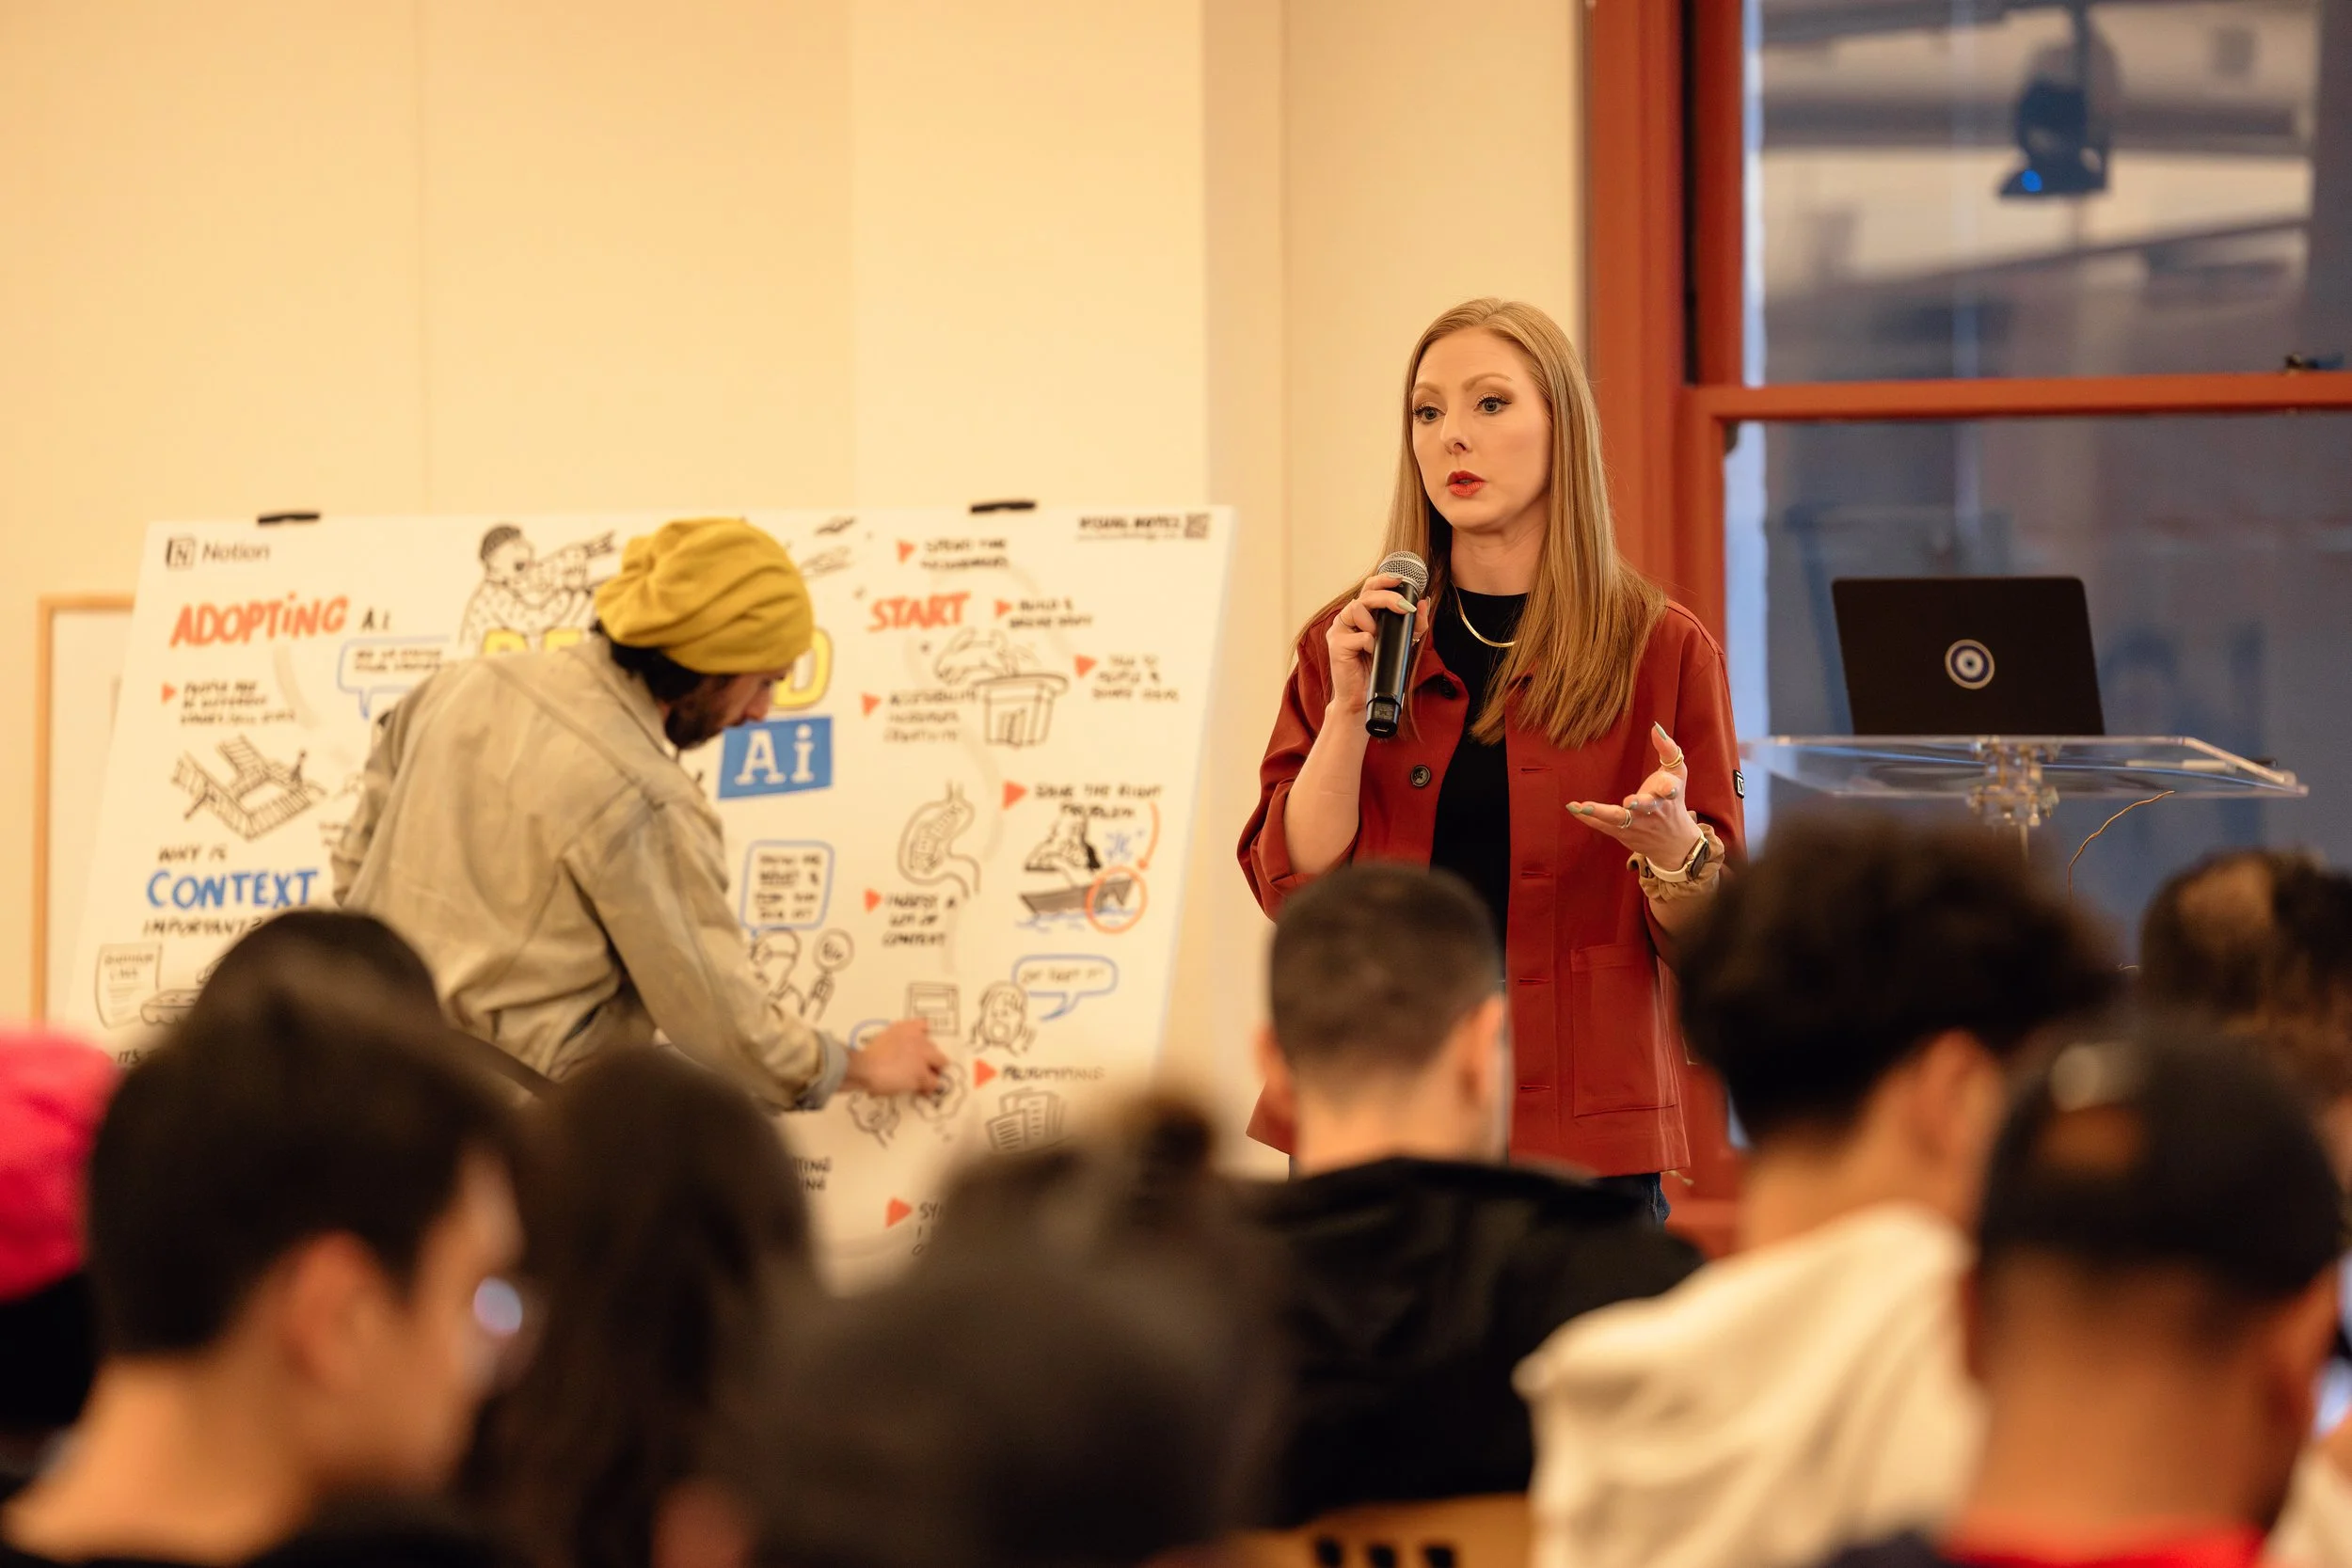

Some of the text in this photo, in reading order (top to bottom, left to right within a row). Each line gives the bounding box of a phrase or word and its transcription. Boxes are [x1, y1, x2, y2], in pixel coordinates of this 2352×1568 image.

[201, 541, 271, 562] Notion
[866, 592, 971, 632] START
[158, 846, 199, 863] WHY
[147, 869, 319, 910] CONTEXT
